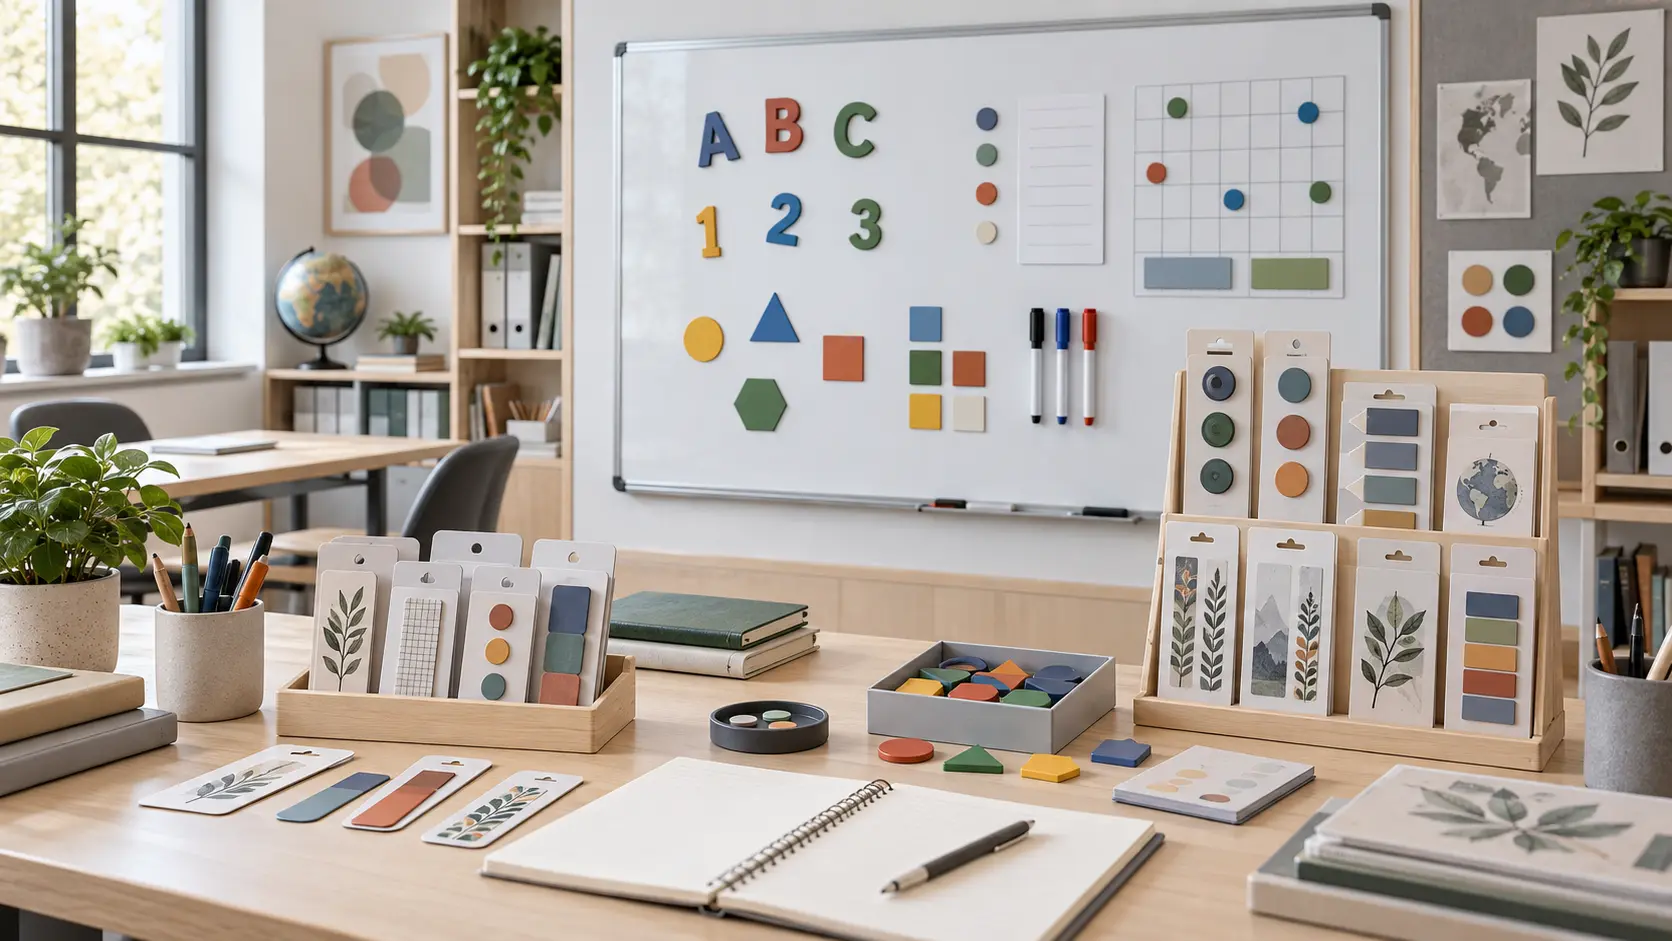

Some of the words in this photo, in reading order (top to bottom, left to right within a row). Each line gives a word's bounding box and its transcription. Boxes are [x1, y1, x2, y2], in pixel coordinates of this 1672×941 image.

[697, 111, 740, 168] A
[765, 97, 804, 154] B
[833, 101, 877, 158] C
[696, 205, 722, 258] 1
[766, 192, 802, 247] 2
[848, 198, 883, 250] 3
